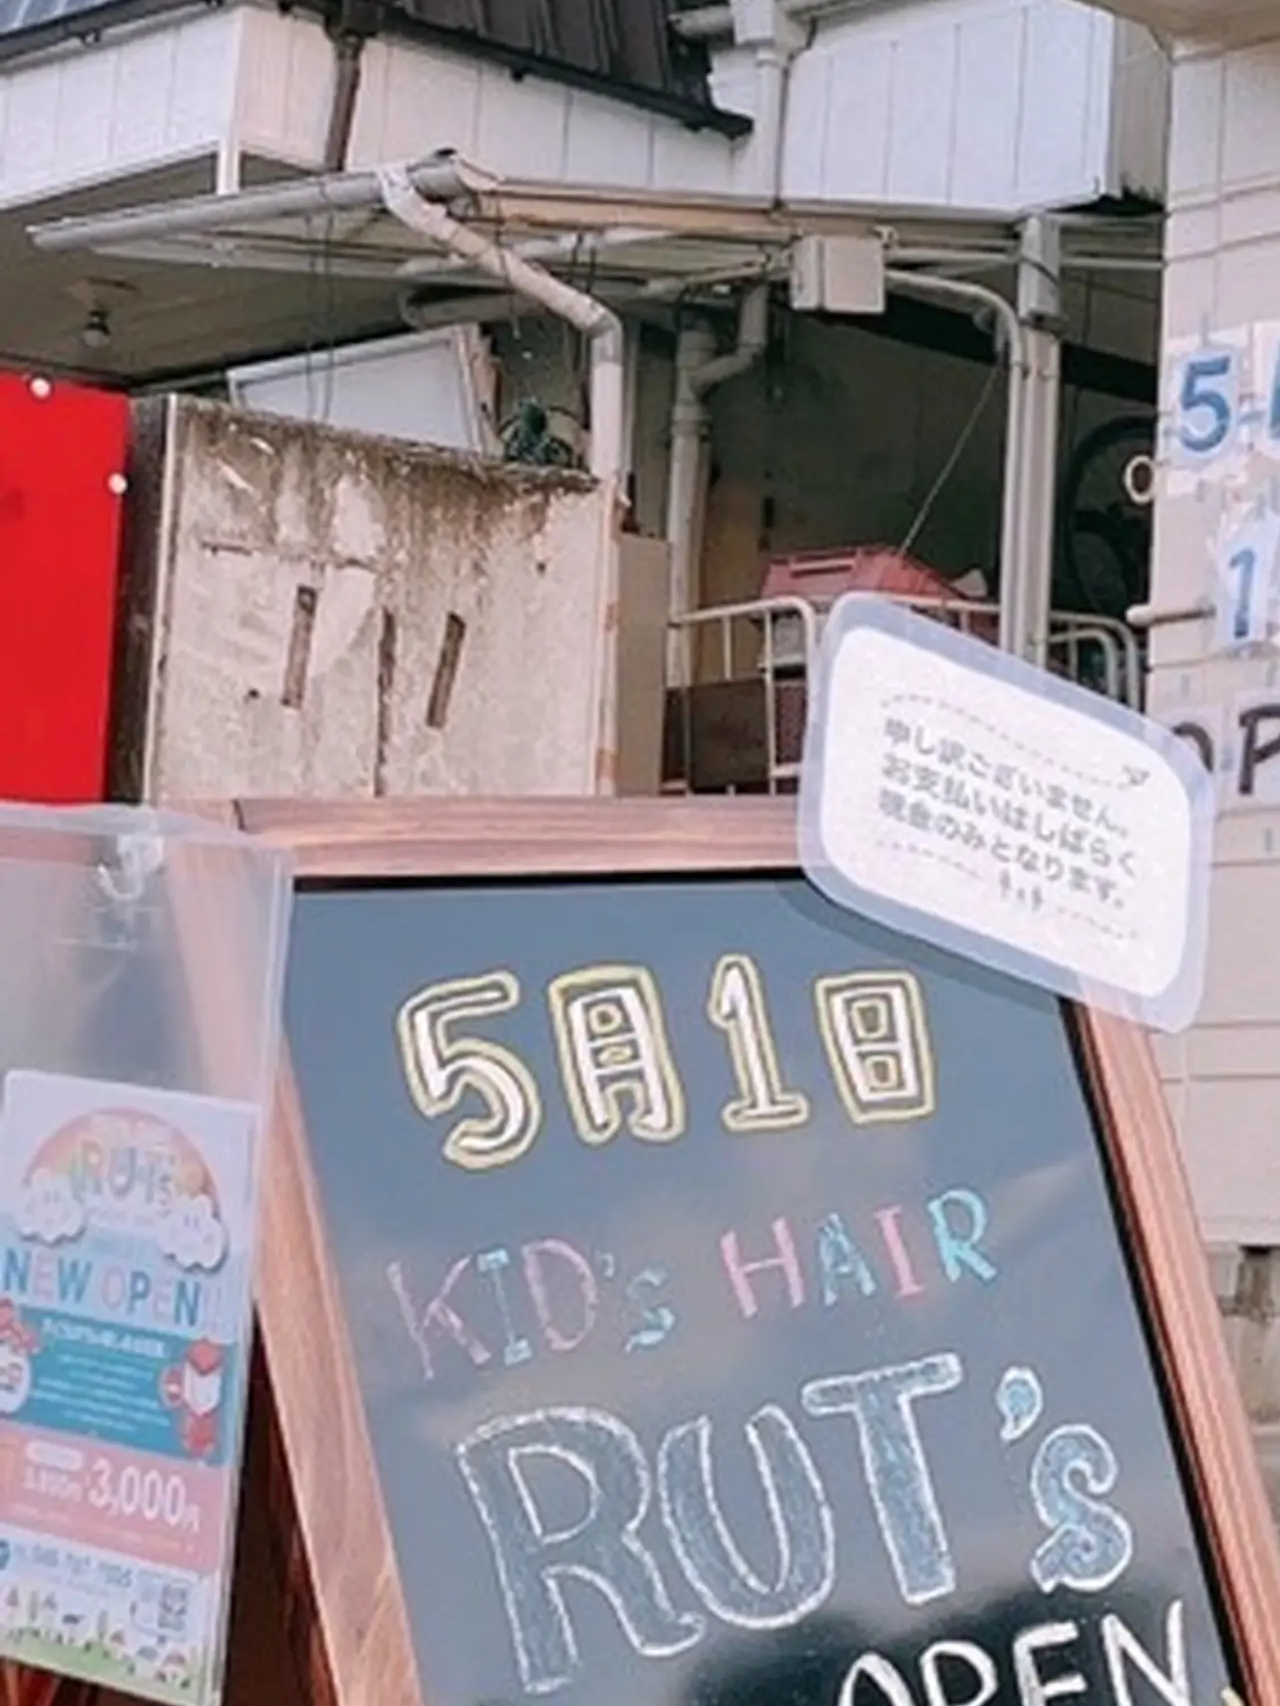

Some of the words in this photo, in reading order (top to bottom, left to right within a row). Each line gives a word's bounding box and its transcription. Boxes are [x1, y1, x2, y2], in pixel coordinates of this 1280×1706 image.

[398, 953, 935, 1170] 5月1日
[3, 1248, 93, 1305] NEW
[389, 1236, 677, 1380] KID's
[719, 1186, 997, 1320] HAIR
[454, 1351, 1133, 1695] RUT's
